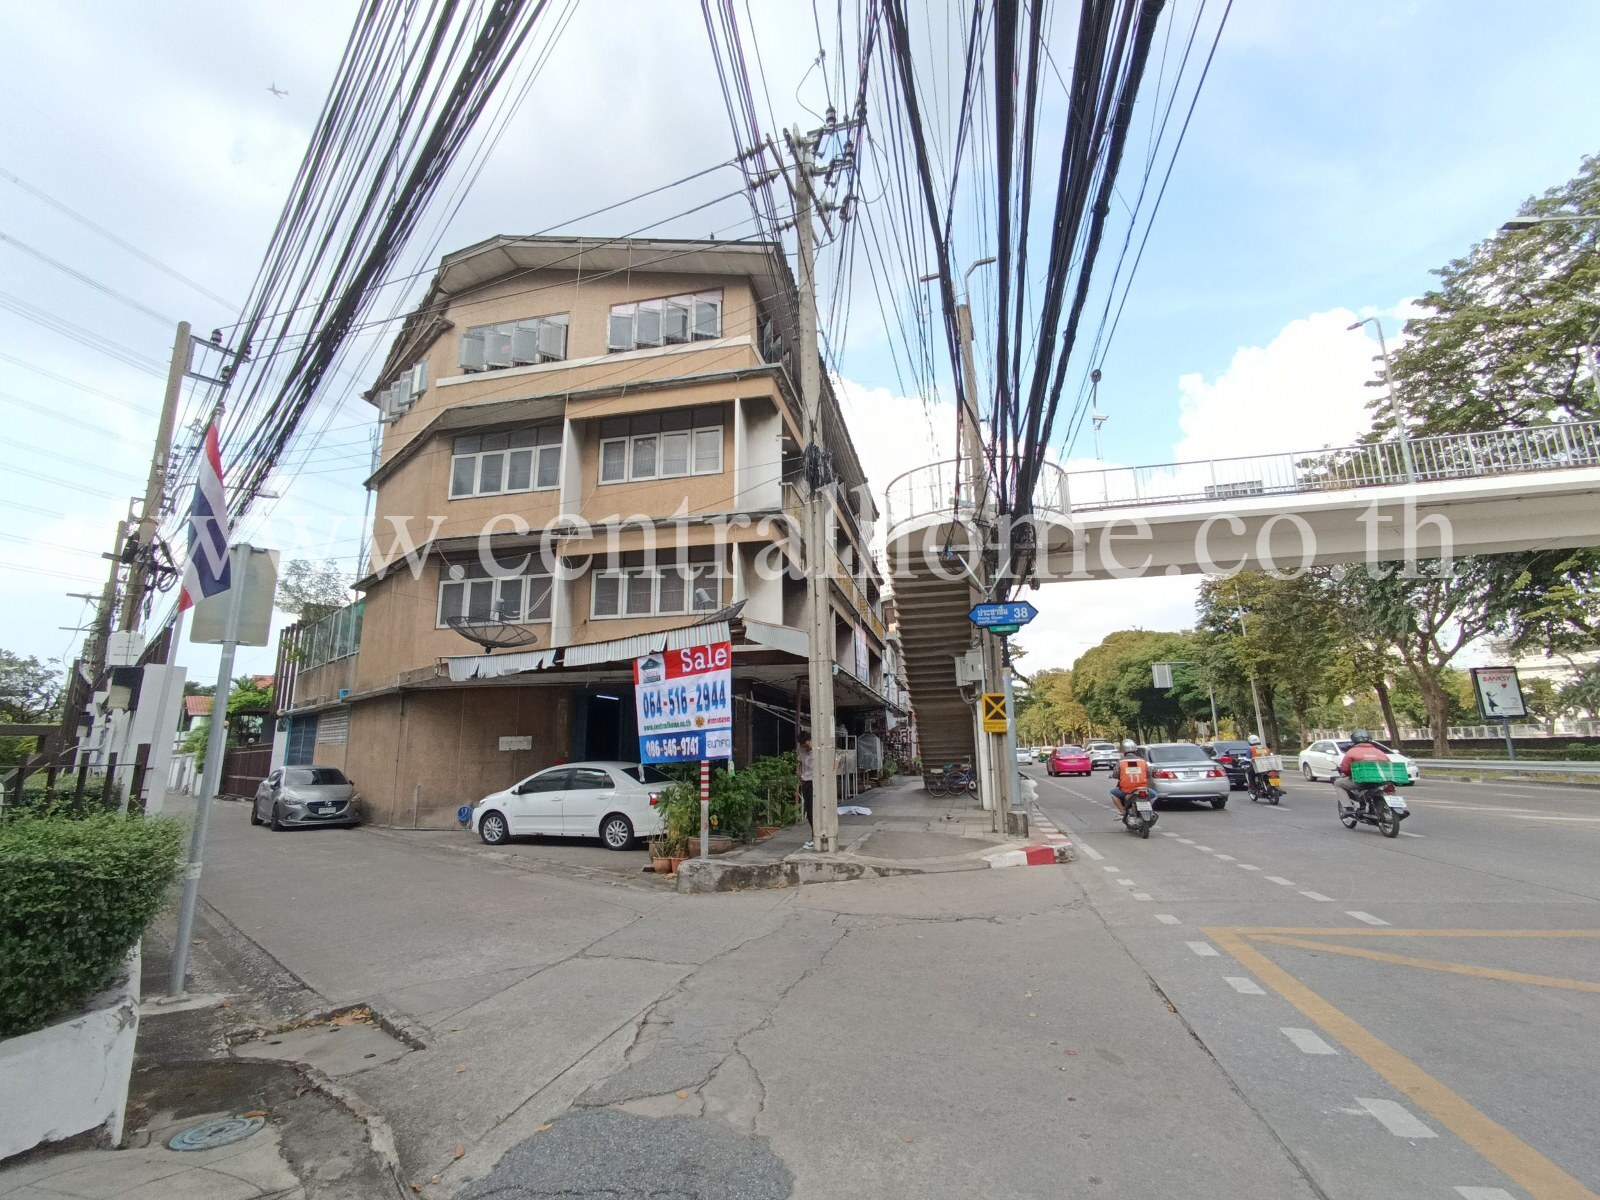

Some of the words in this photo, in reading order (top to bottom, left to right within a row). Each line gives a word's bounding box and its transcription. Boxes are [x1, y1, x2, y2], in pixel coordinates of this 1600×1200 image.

[1013, 607, 1028, 618] 38
[681, 644, 728, 673] Sale
[643, 680, 727, 719] 064-516-2944
